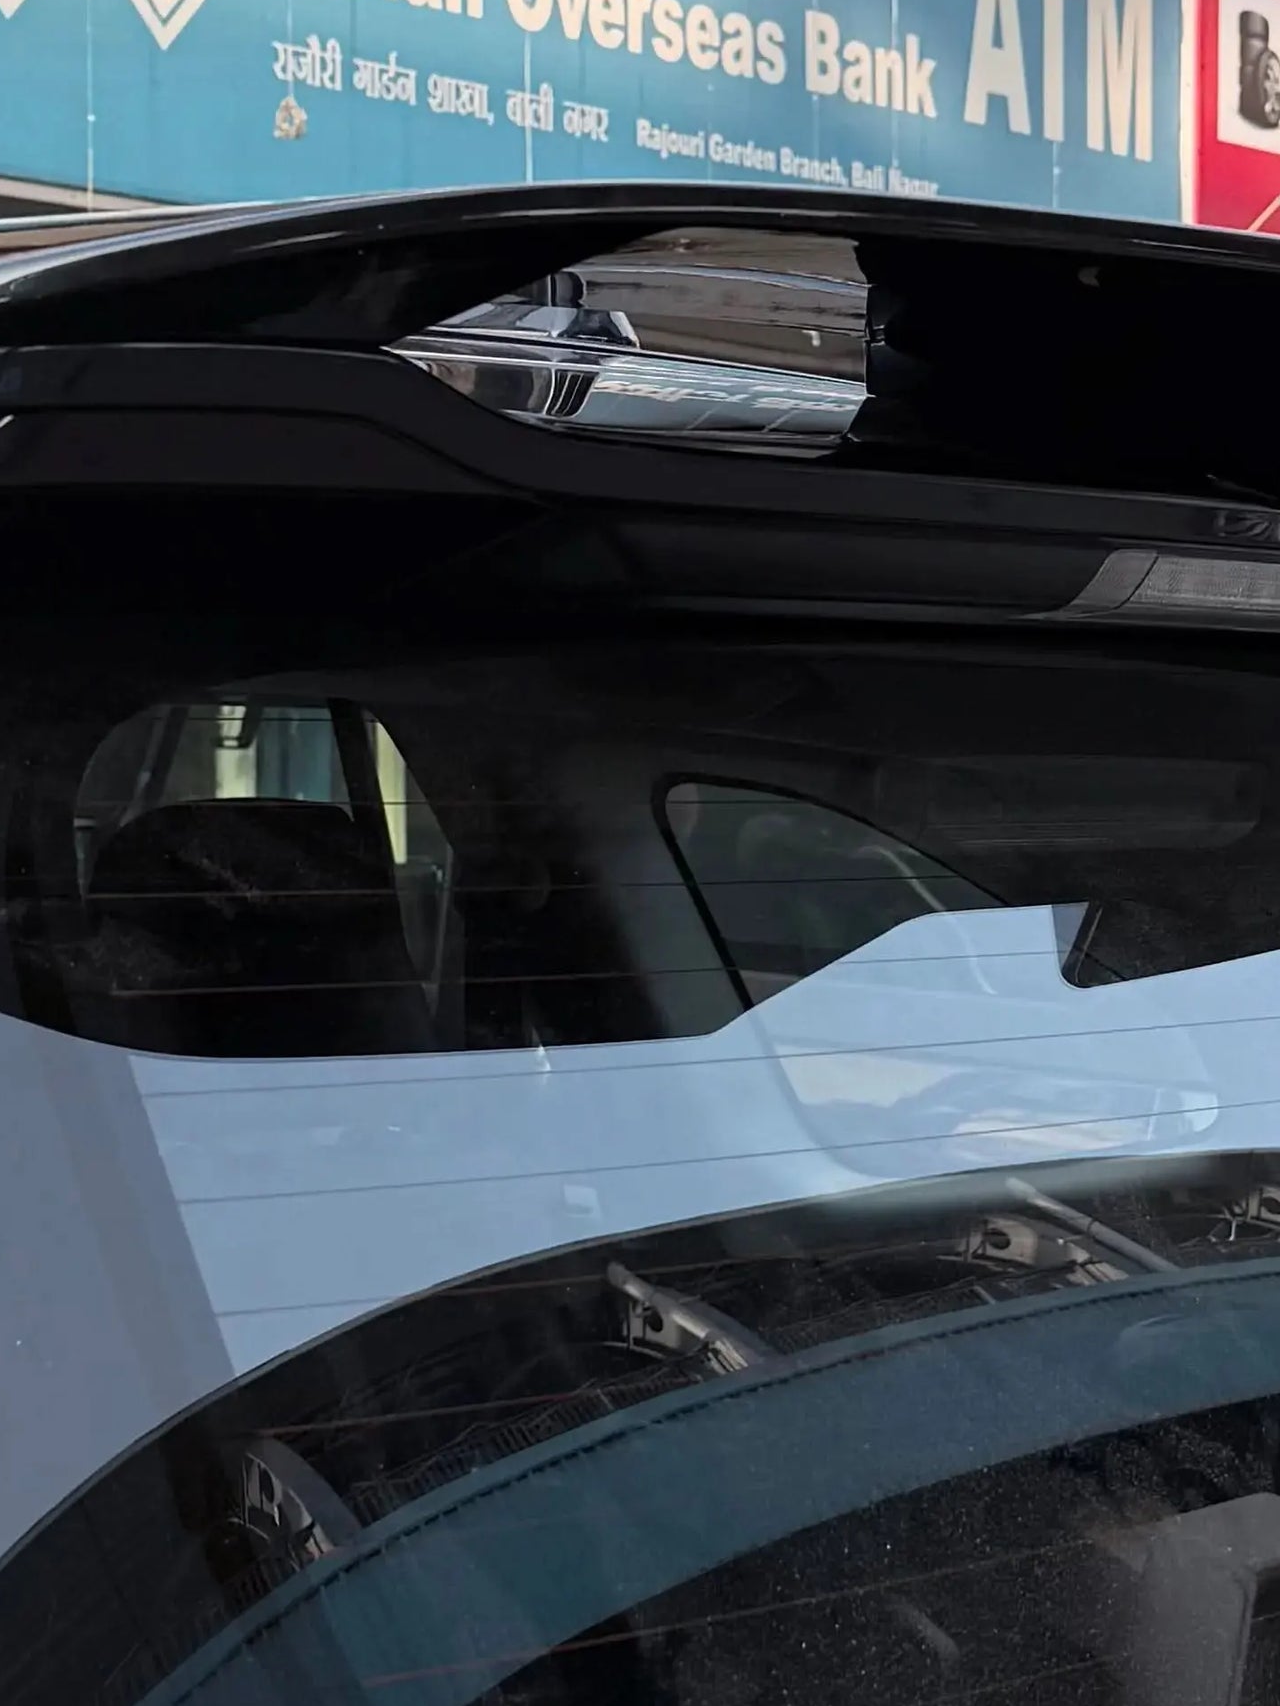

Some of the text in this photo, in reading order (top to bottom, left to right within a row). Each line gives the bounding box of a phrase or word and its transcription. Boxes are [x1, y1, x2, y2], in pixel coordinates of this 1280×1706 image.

[803, 9, 939, 120] Bank
[635, 117, 706, 162] Rajouri
[709, 134, 777, 173] Garden
[851, 159, 885, 191] Bali
